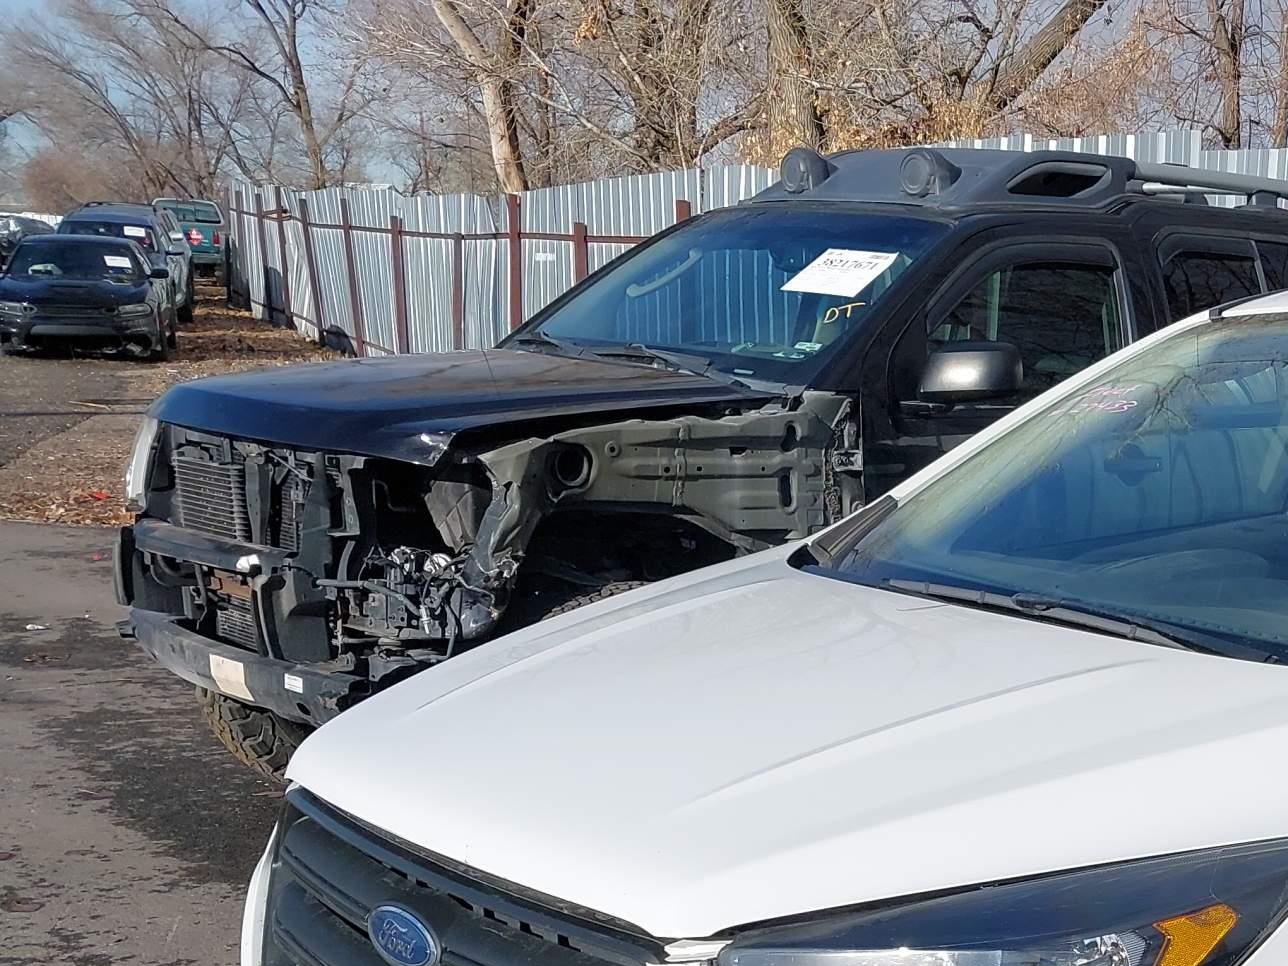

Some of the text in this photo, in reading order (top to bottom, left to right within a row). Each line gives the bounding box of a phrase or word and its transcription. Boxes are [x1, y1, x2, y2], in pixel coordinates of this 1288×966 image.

[823, 258, 880, 270] 38217671
[823, 302, 866, 324] DT
[379, 918, 418, 959] Ford
